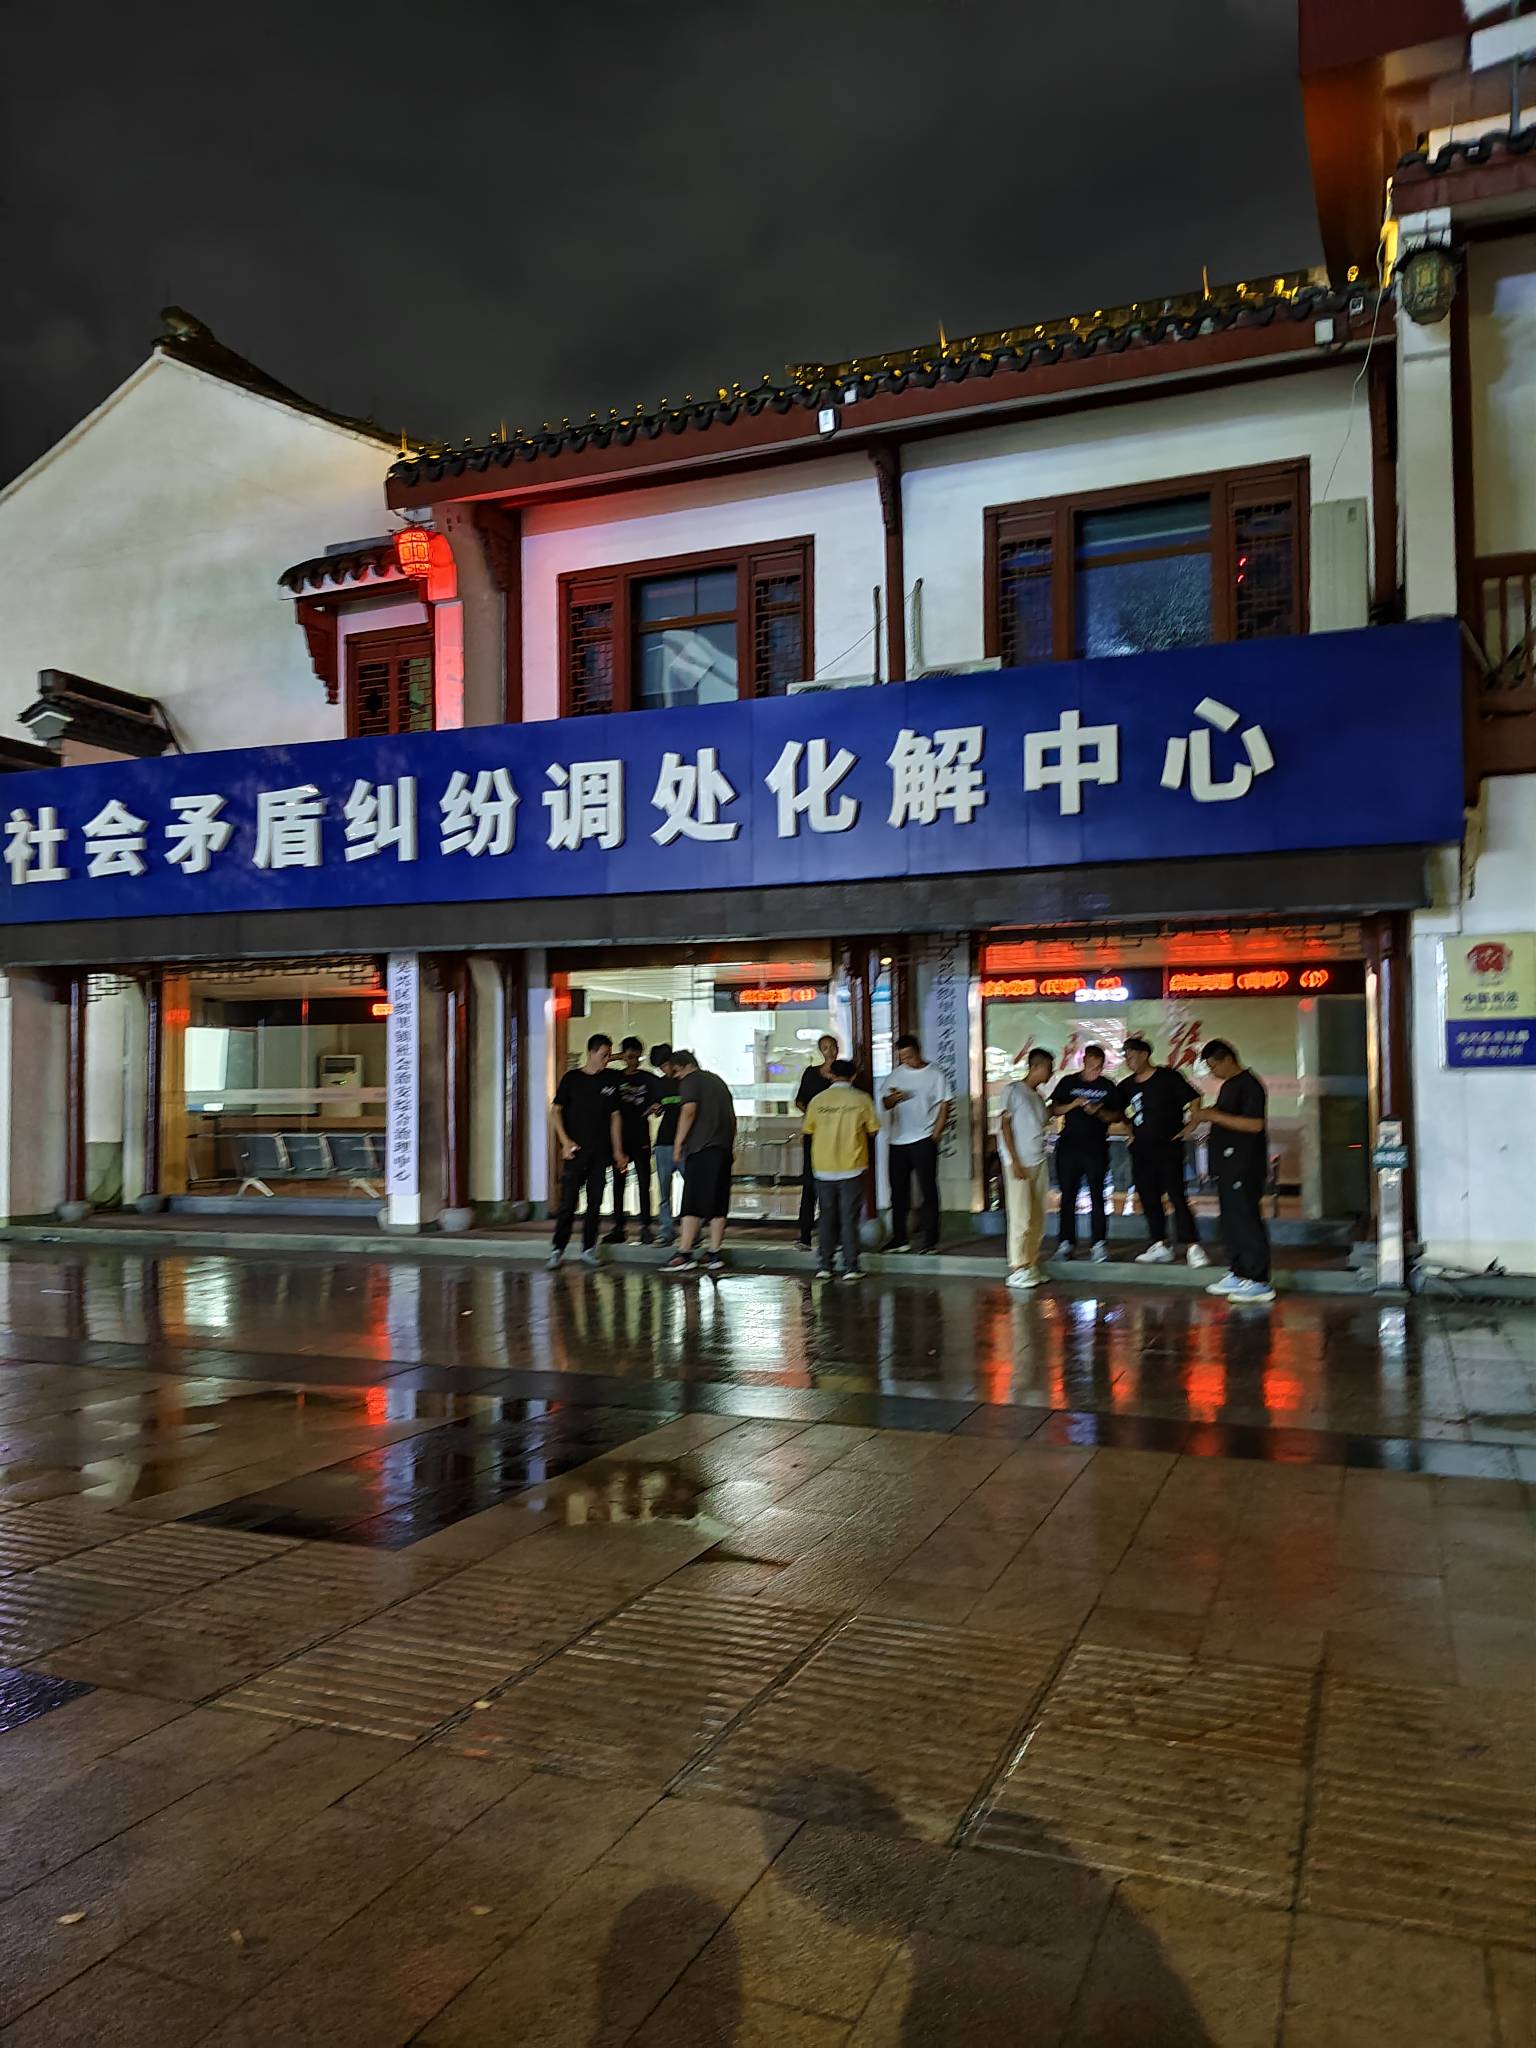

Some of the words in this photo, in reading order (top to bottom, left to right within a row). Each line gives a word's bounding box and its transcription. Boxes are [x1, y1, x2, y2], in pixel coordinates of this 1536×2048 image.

[3, 697, 1275, 886] 社会矛盾纠纷调处化解中心
